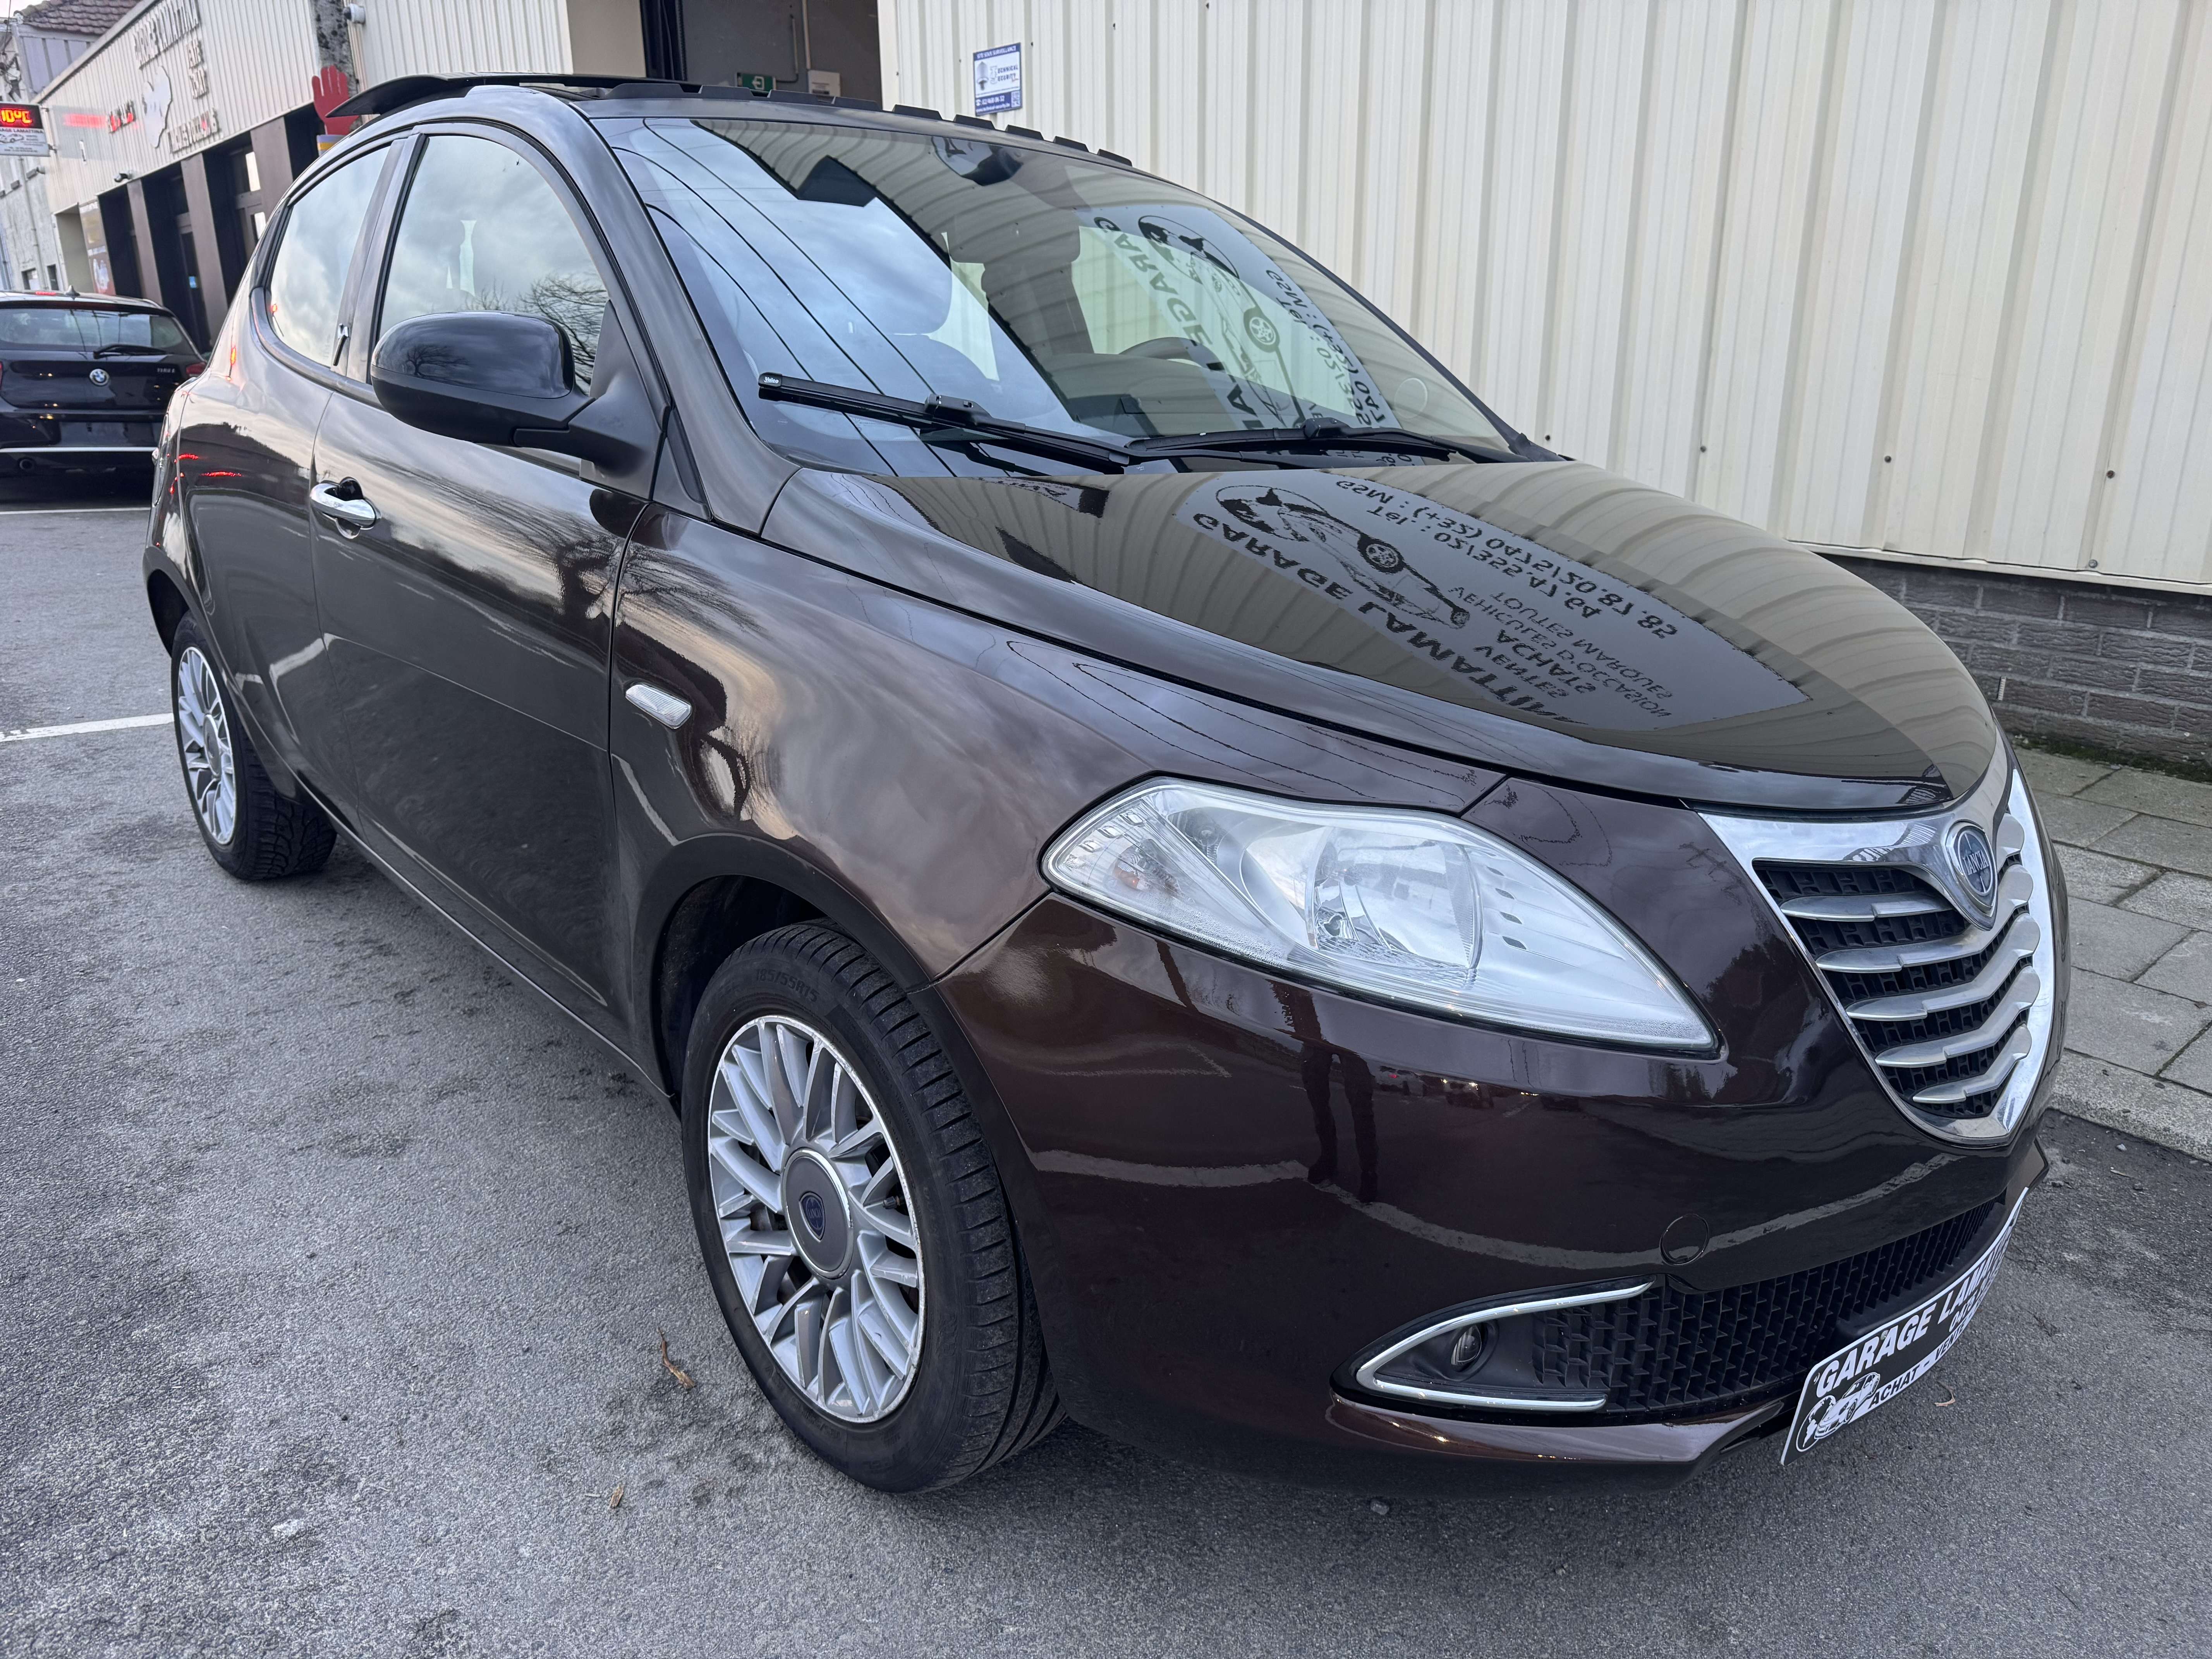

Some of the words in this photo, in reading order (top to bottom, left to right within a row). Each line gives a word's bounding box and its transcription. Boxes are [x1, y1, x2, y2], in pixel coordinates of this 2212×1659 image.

[1962, 850, 1989, 875] LANCIA
[756, 969, 820, 1002] 185/55R15
[808, 1208, 822, 1218] LANCIA
[1816, 1302, 1937, 1398] GARAGE
[1868, 1364, 1921, 1409] ACHAT
